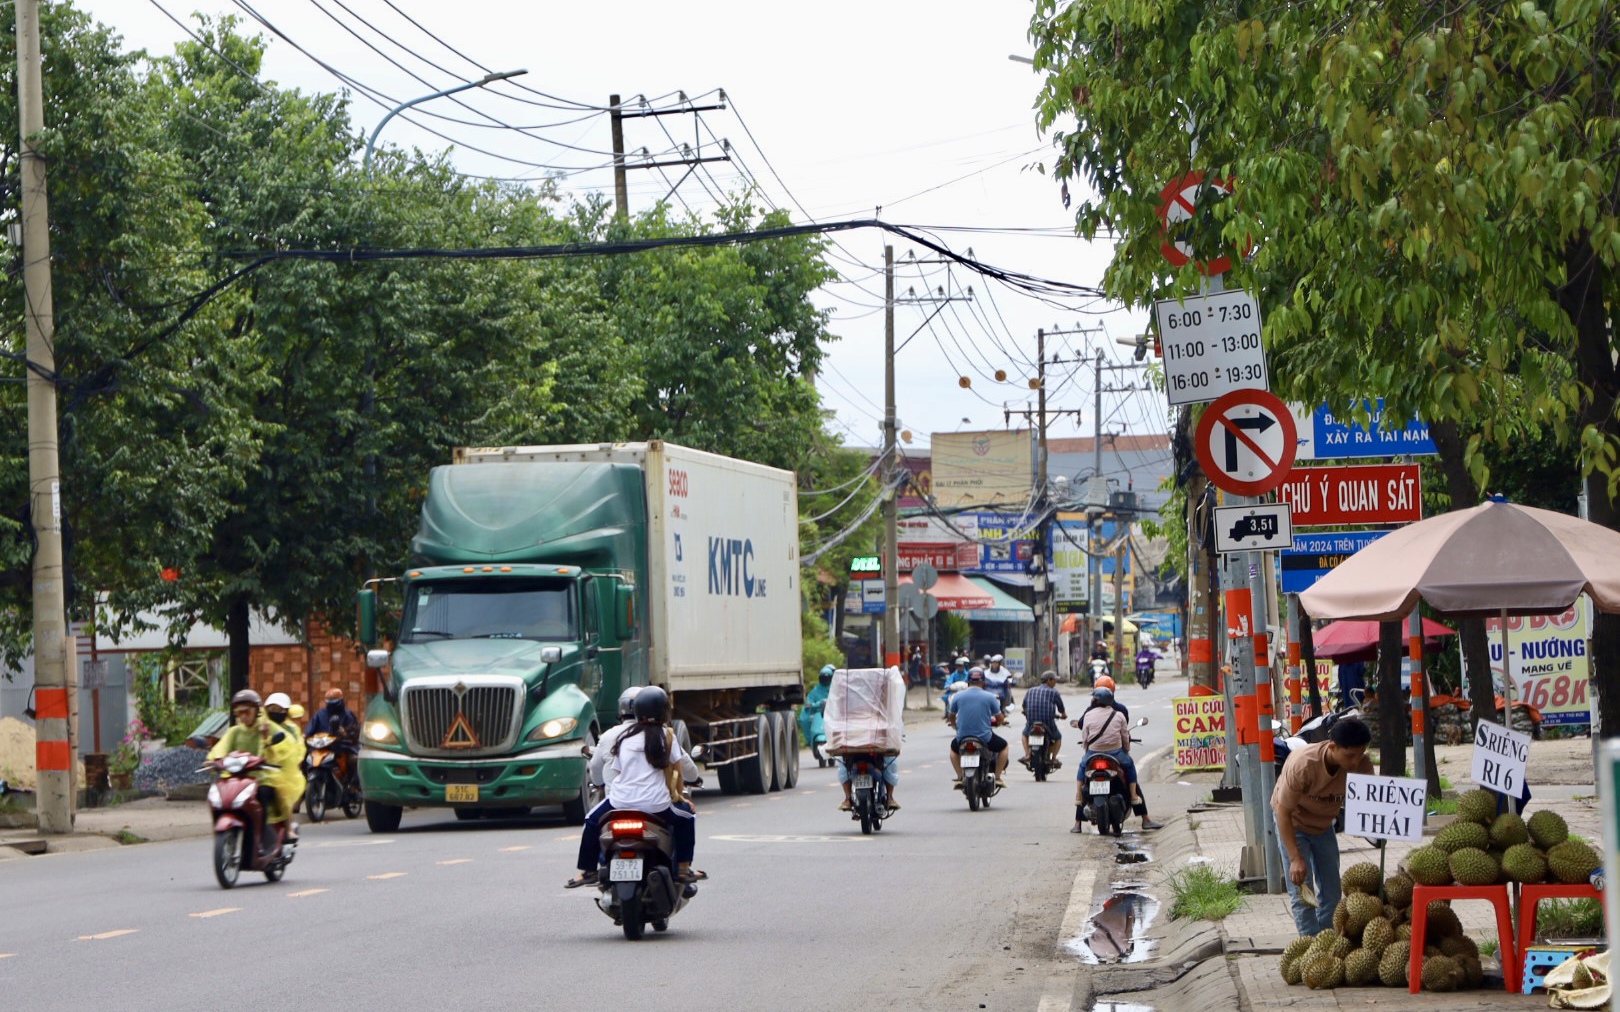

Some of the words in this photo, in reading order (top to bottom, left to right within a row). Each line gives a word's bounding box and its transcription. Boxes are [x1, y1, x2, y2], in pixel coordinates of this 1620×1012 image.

[1168, 311, 1202, 329] 6:00
[1219, 303, 1251, 323] 7:30
[1168, 341, 1205, 360] 11:00
[1221, 333, 1259, 353] 13:00
[1171, 371, 1209, 391] 16:00
[1226, 363, 1262, 384] 19:30
[1325, 429, 1349, 445] XẢY
[1355, 431, 1373, 443] RA
[1379, 430, 1398, 442] TAI
[1403, 429, 1429, 445] NẠN
[1282, 475, 1311, 514] CHÚ
[1319, 474, 1330, 512] Ý
[1338, 480, 1379, 513] QUAN
[1387, 472, 1415, 511] SÁT
[1250, 518, 1273, 532] 3,5t
[1309, 540, 1333, 552] 2024
[1333, 537, 1355, 551] TRÊN
[708, 536, 755, 599] KMTC
[754, 579, 767, 598] LINE
[1319, 554, 1328, 568] ĐÃ
[1521, 636, 1585, 660] NƯỚNG
[1521, 664, 1554, 674] MANG
[1522, 675, 1588, 710] 168K
[1176, 699, 1199, 715] GIẢI
[1202, 698, 1225, 714] CỨU
[1176, 716, 1225, 733] CAM
[1482, 758, 1502, 787] RI
[1504, 768, 1515, 791] 6
[1347, 781, 1361, 801] S.
[1366, 779, 1424, 807] RIÊNG
[1357, 808, 1411, 837] THÁI
